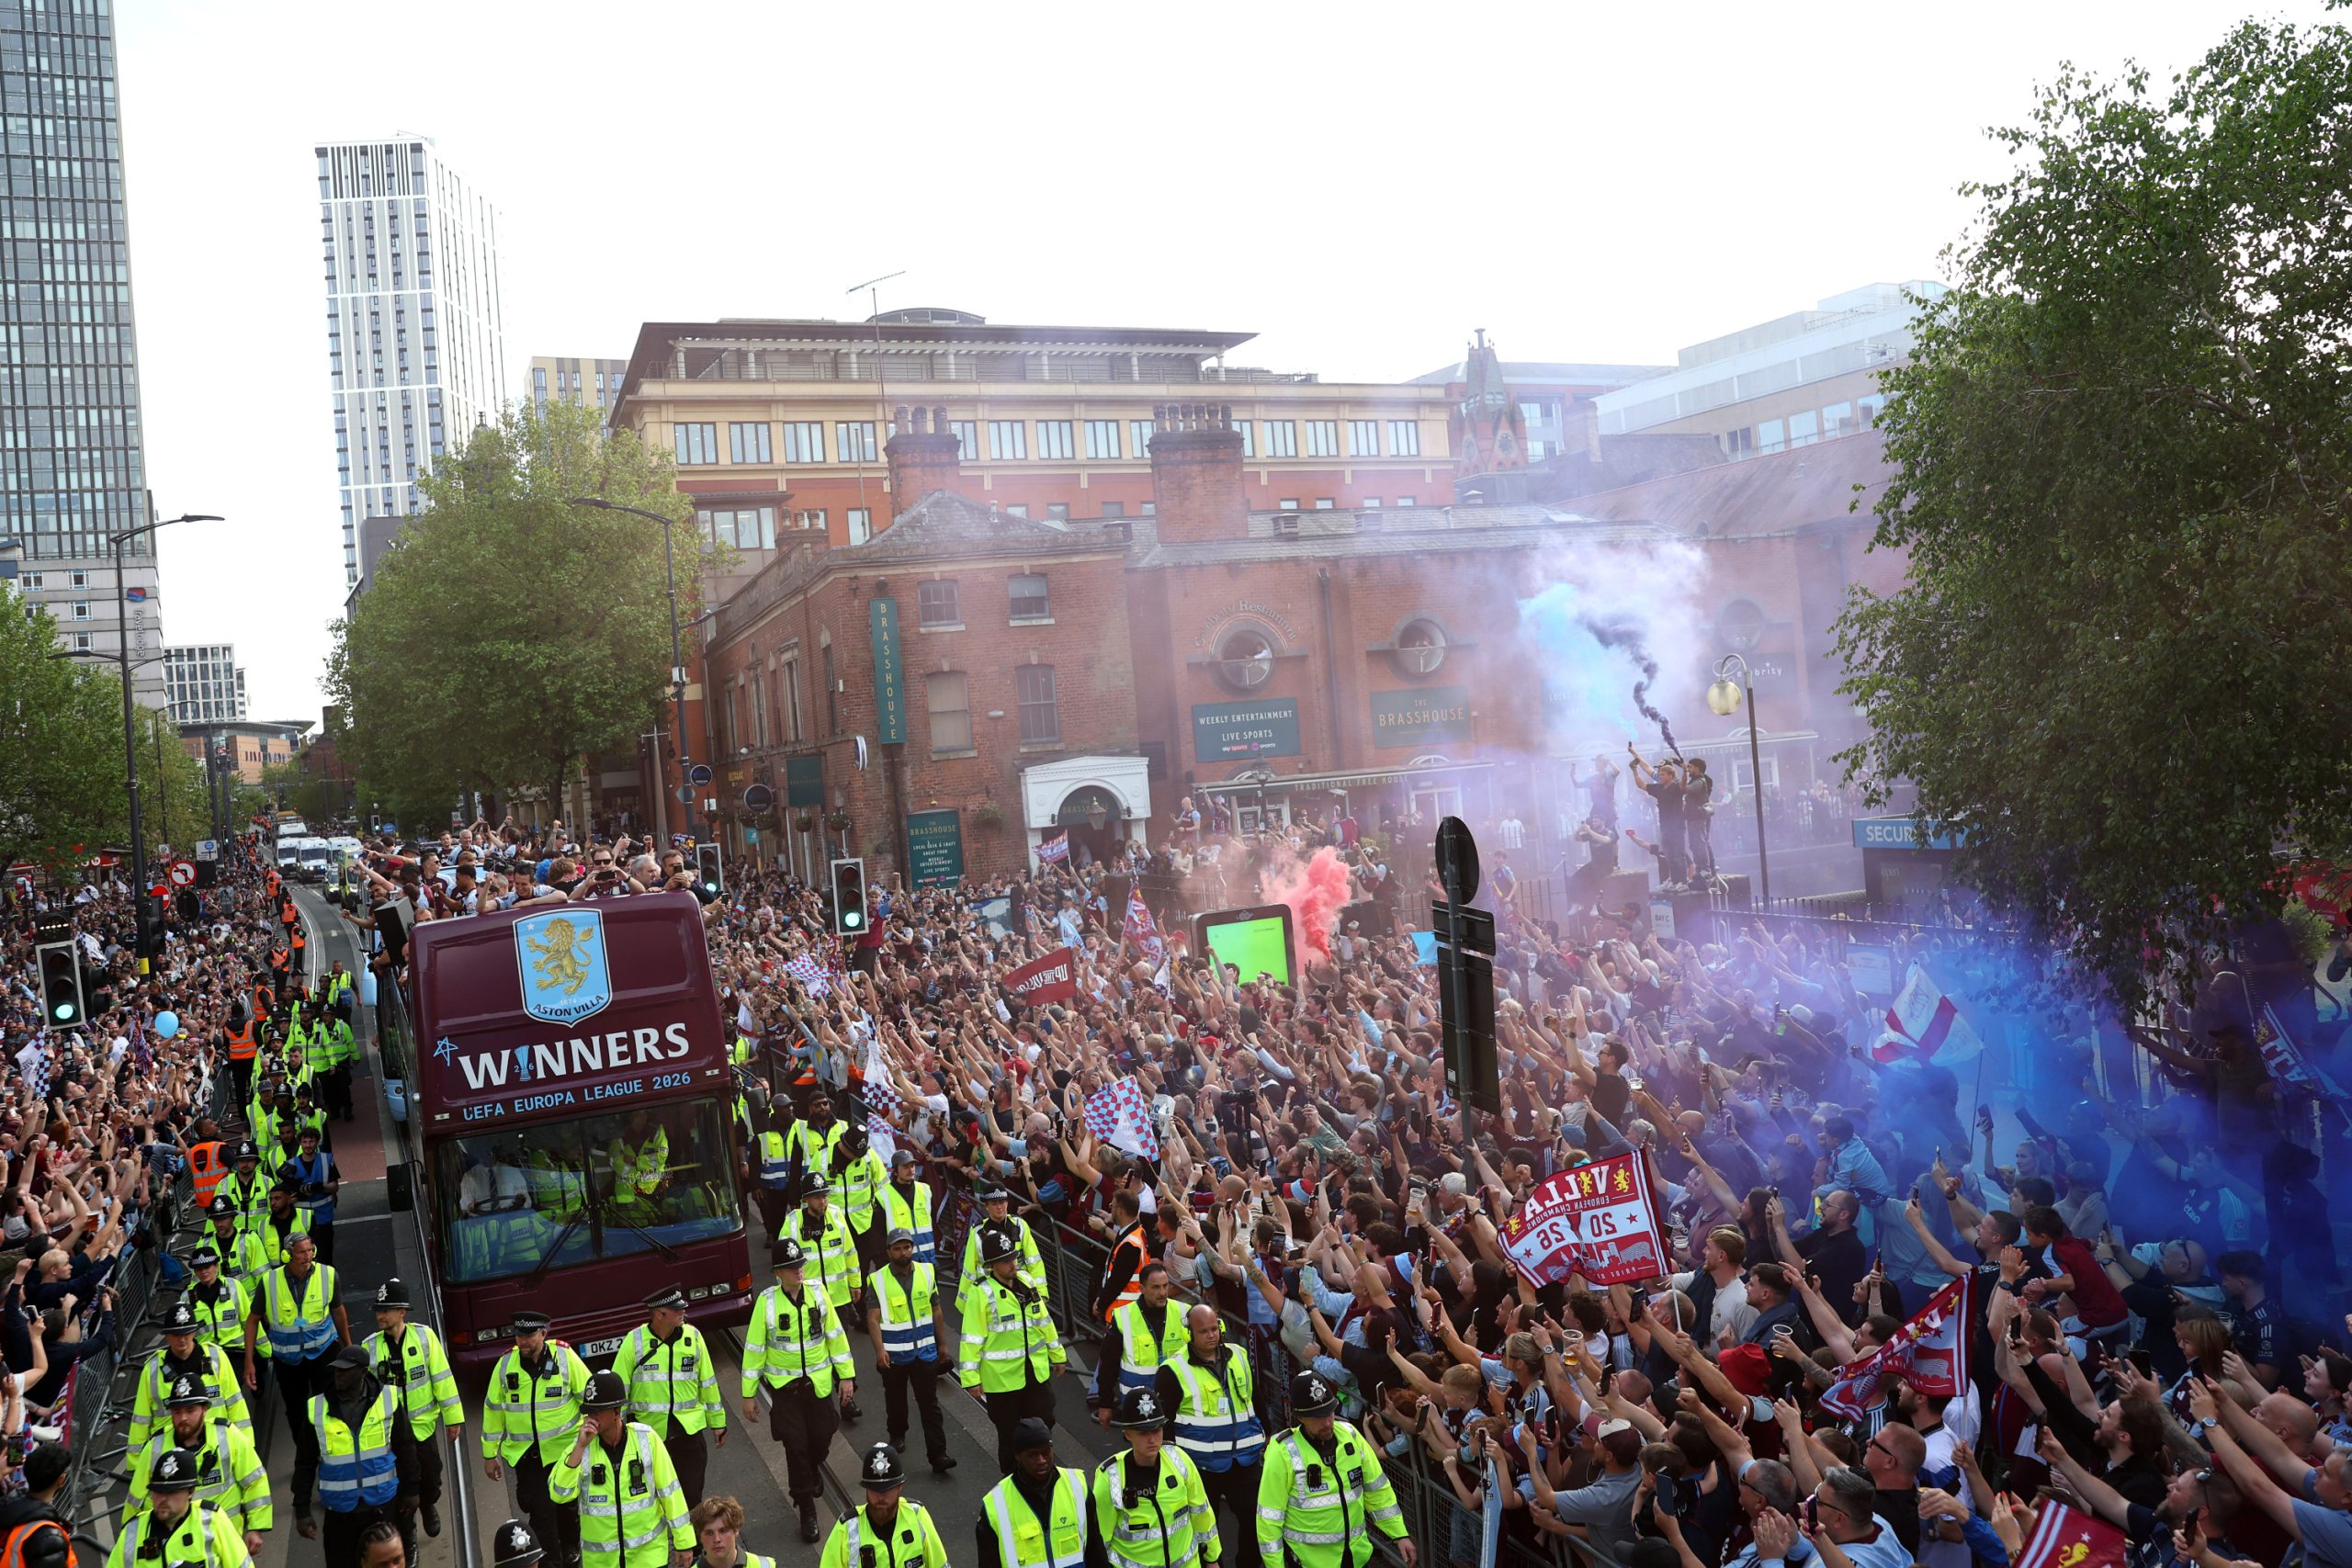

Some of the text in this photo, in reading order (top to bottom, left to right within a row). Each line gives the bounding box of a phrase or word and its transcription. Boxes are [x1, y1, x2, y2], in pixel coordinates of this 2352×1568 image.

[1238, 599, 1297, 639] Restaurant
[133, 607, 145, 657] Travelodge
[879, 602, 898, 739] BRASSHOUSE
[1414, 699, 1427, 707] THE
[1198, 710, 1293, 726] WEEKLY ENTERTAINMENT
[1379, 707, 1464, 727] BRASSHOUSE
[1222, 729, 1273, 741] LIVE SPORTS
[1295, 774, 1410, 792] TRADITIONAL FREE HOUSE
[910, 825, 956, 836] BRASSHOUSE
[533, 995, 605, 1017] ASTON VILLA
[463, 1072, 692, 1121] UEFA EUROPA LEAGUE 2026
[591, 1340, 615, 1354] OKZ
